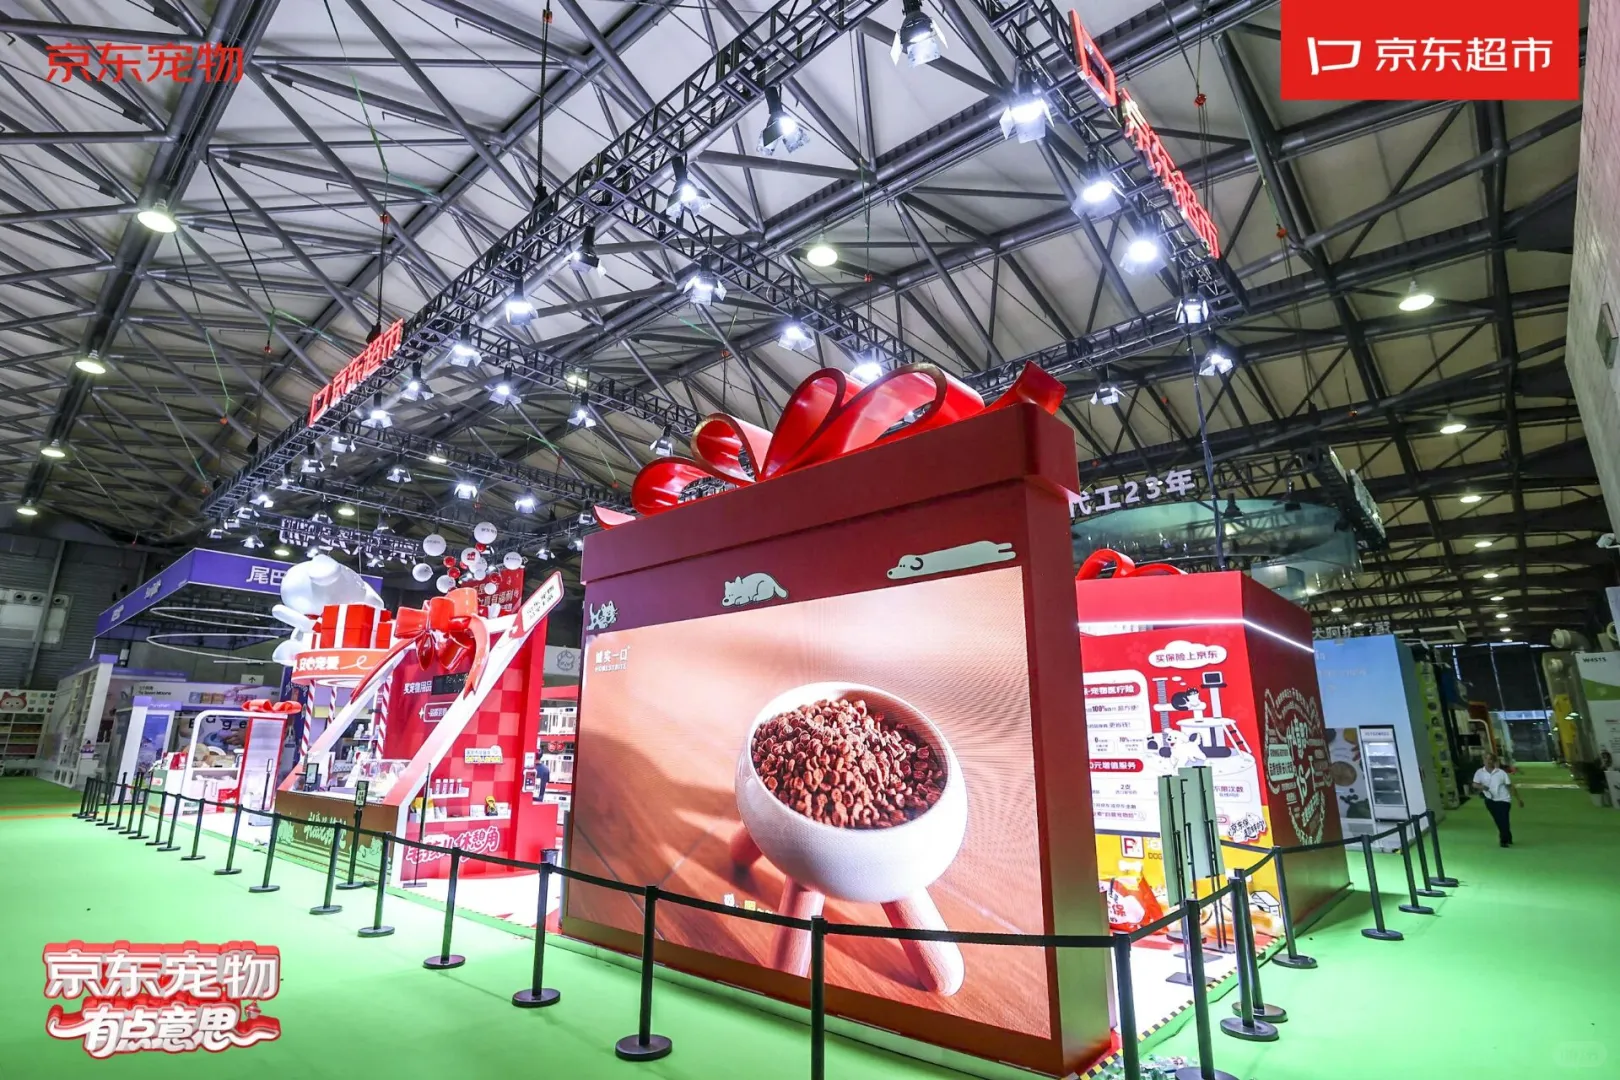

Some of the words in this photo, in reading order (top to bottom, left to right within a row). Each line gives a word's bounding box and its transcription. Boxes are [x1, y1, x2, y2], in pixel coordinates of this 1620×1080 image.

[1155, 650, 1218, 663] 买保险上京东
